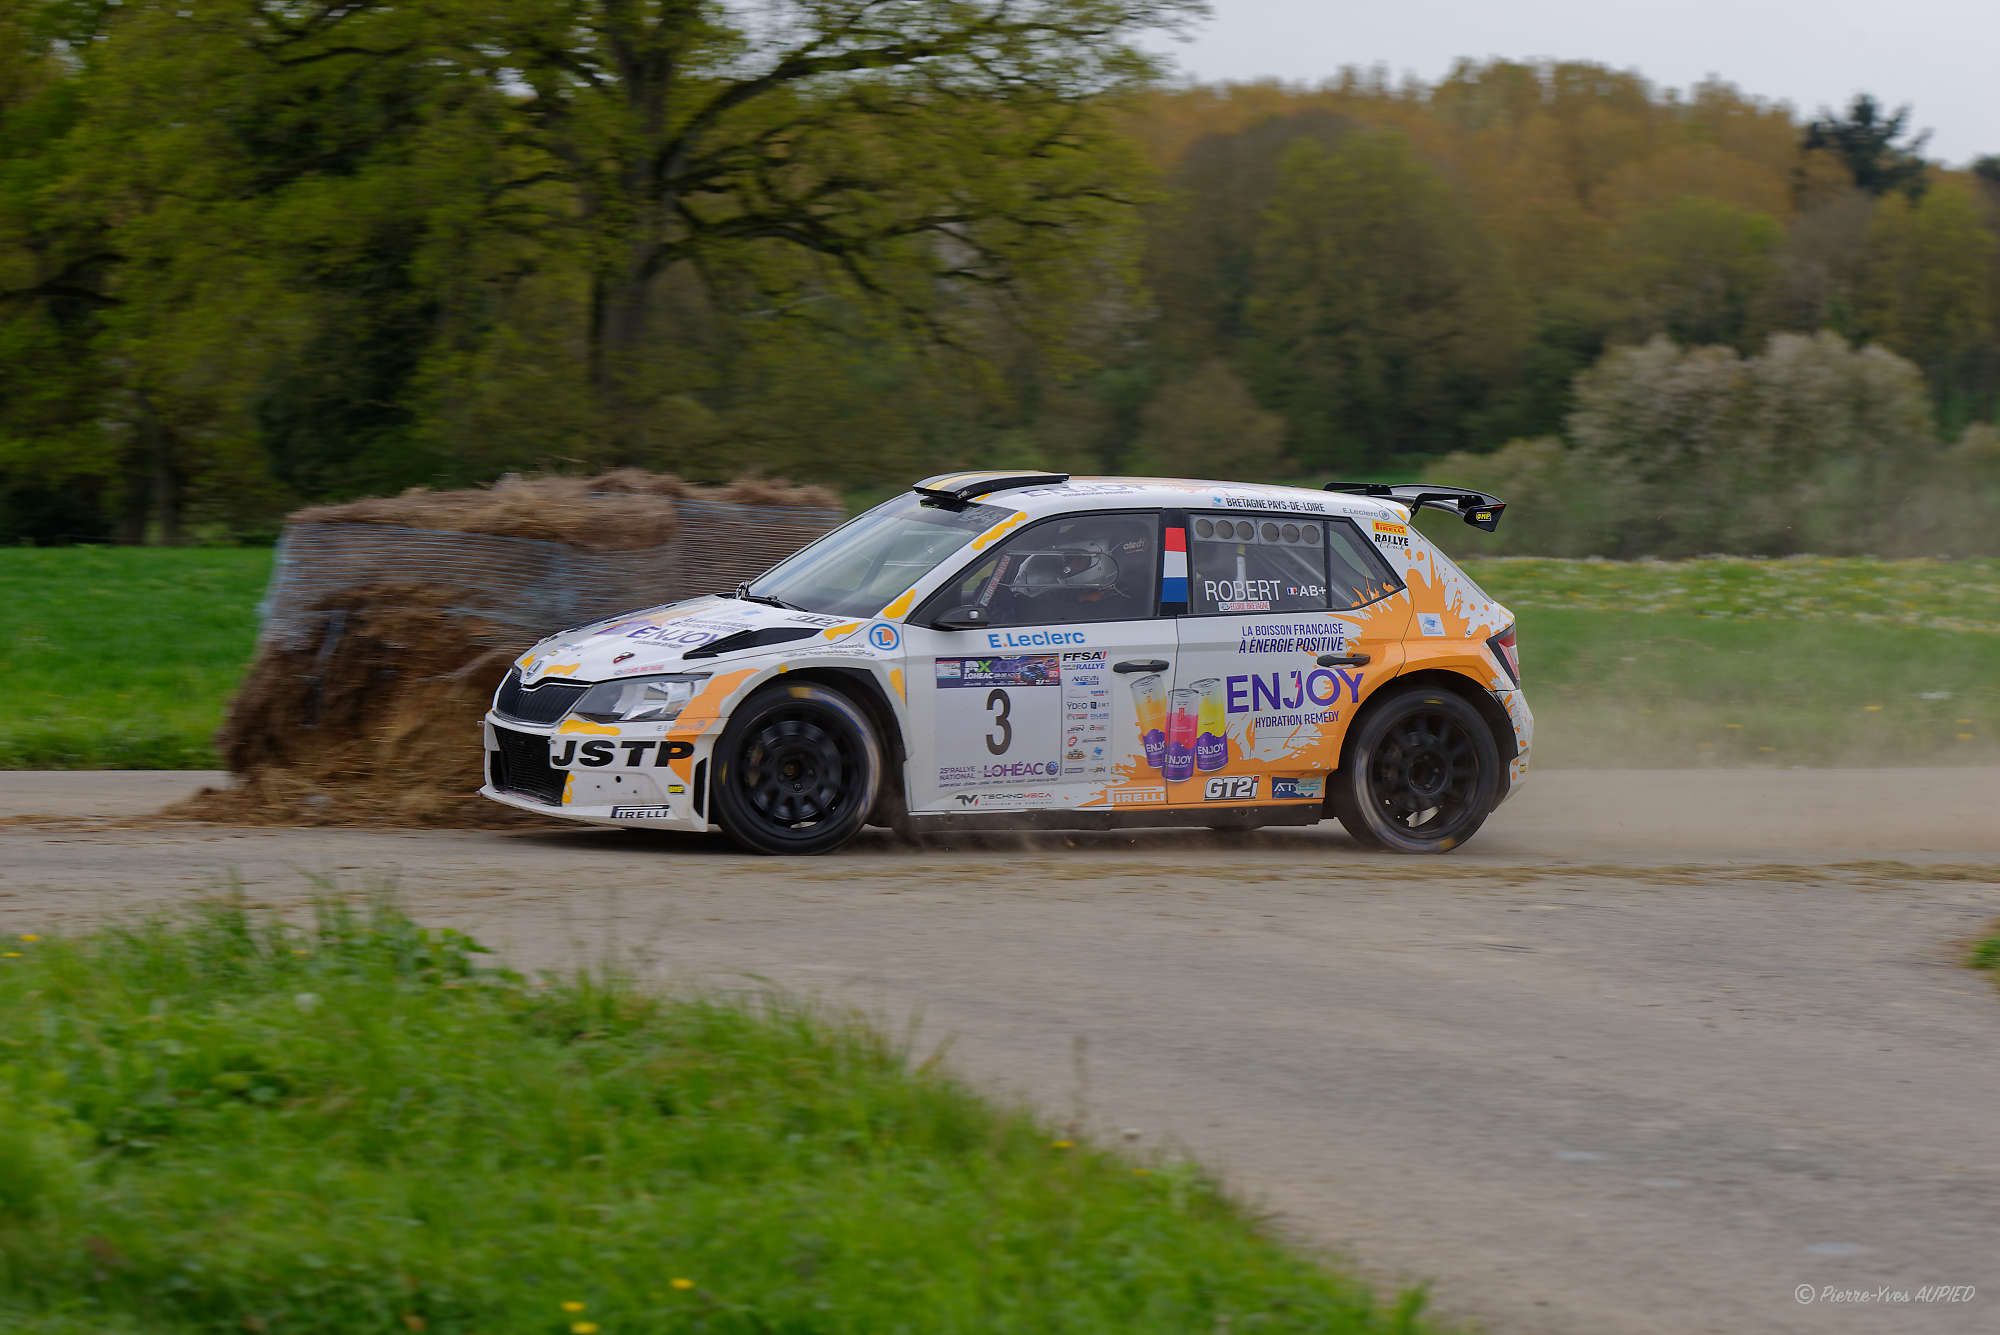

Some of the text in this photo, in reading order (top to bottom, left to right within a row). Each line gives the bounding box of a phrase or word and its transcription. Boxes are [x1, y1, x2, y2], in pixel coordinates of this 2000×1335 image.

[1225, 497, 1325, 512] BRETAGNE PAYS-DE-LOIRE
[1476, 512, 1491, 520] OMP
[1375, 522, 1406, 534] PIRELLI
[1375, 533, 1409, 546] RALLYE
[1204, 580, 1281, 601] ROBERT
[1299, 585, 1327, 597] AB+
[1242, 625, 1253, 637] LA
[1255, 624, 1292, 636] BOISSON
[987, 631, 1086, 649] E.Leclerc
[1239, 636, 1345, 654] À ÉNERGIE POSITIVE
[1063, 651, 1102, 661] FFSA
[1226, 669, 1364, 713] ENJOY
[986, 688, 1012, 755] 3
[1255, 711, 1340, 728] HYDRATION REMEDY
[551, 740, 694, 767] JSTP
[1197, 743, 1225, 755] ENJOY
[1165, 754, 1192, 765] ENJOY
[983, 761, 1044, 777] LOHÉAC
[1105, 786, 1165, 803] PIRELLI
[1204, 776, 1259, 800] GT2i
[981, 792, 1052, 800] TECHNOMECA
[610, 805, 670, 818] PIRELLI
